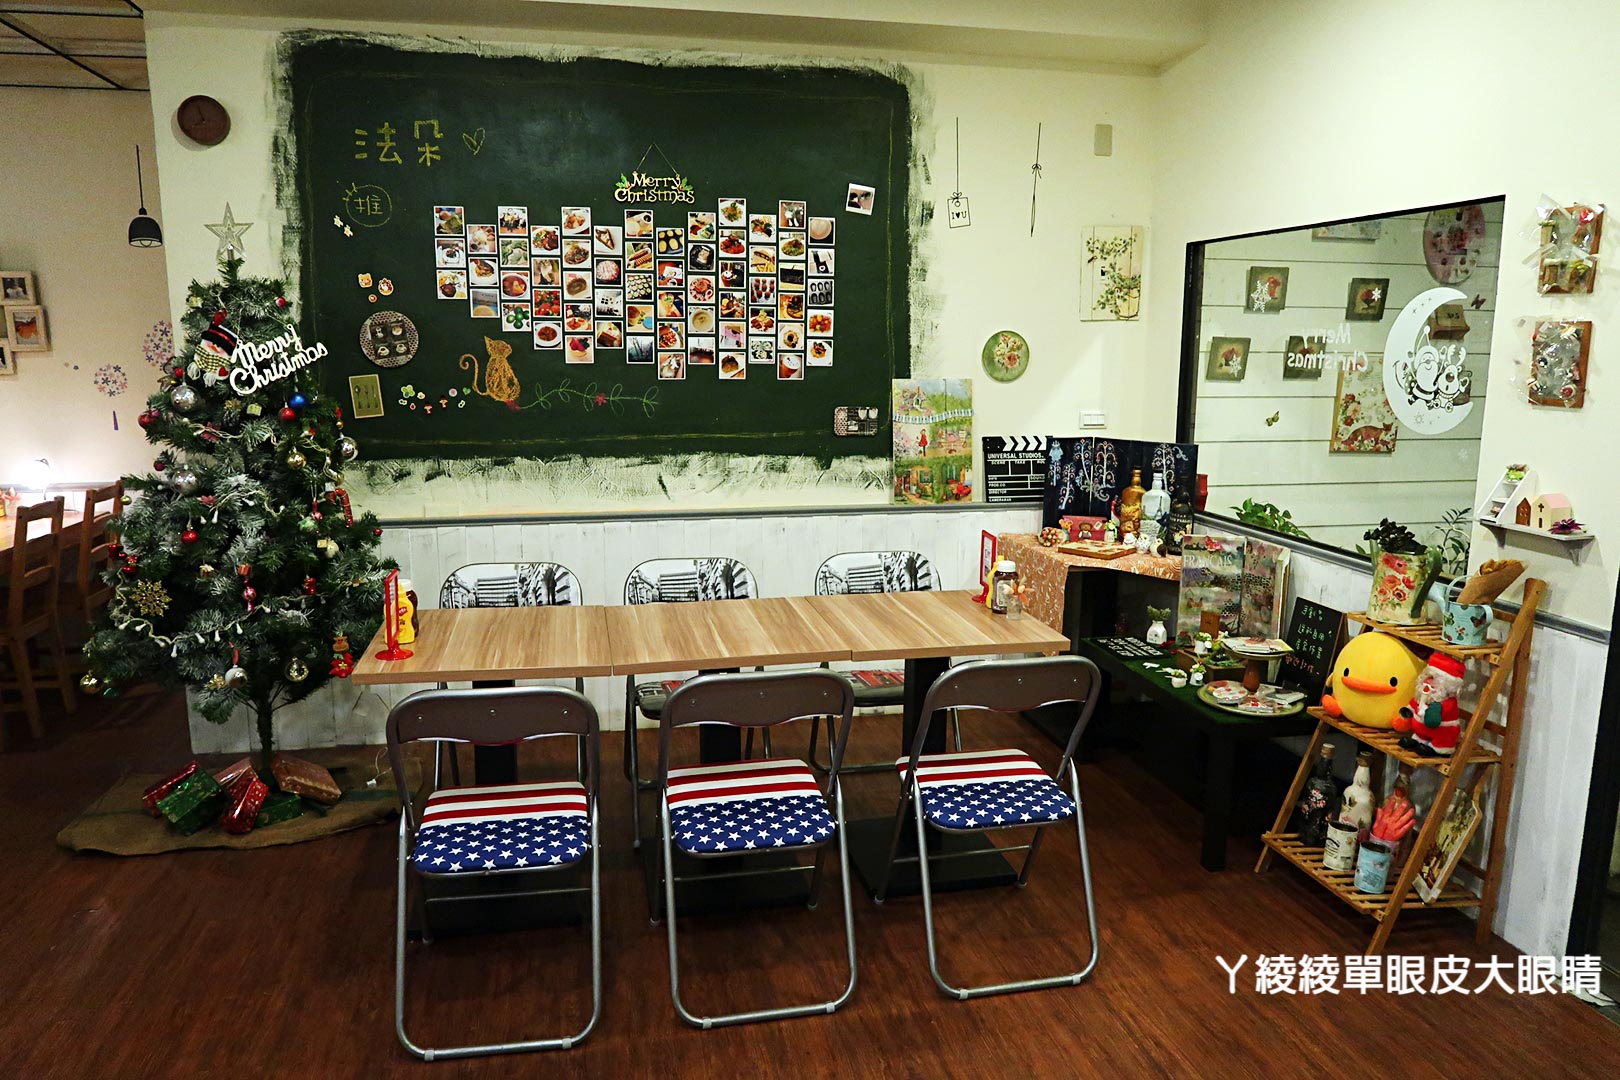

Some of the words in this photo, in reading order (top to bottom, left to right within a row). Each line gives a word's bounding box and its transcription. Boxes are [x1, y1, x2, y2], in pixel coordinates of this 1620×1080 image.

[614, 188, 696, 204] Christmas
[631, 171, 681, 190] Merry
[231, 323, 301, 369] Merry
[230, 342, 328, 395] Christmas
